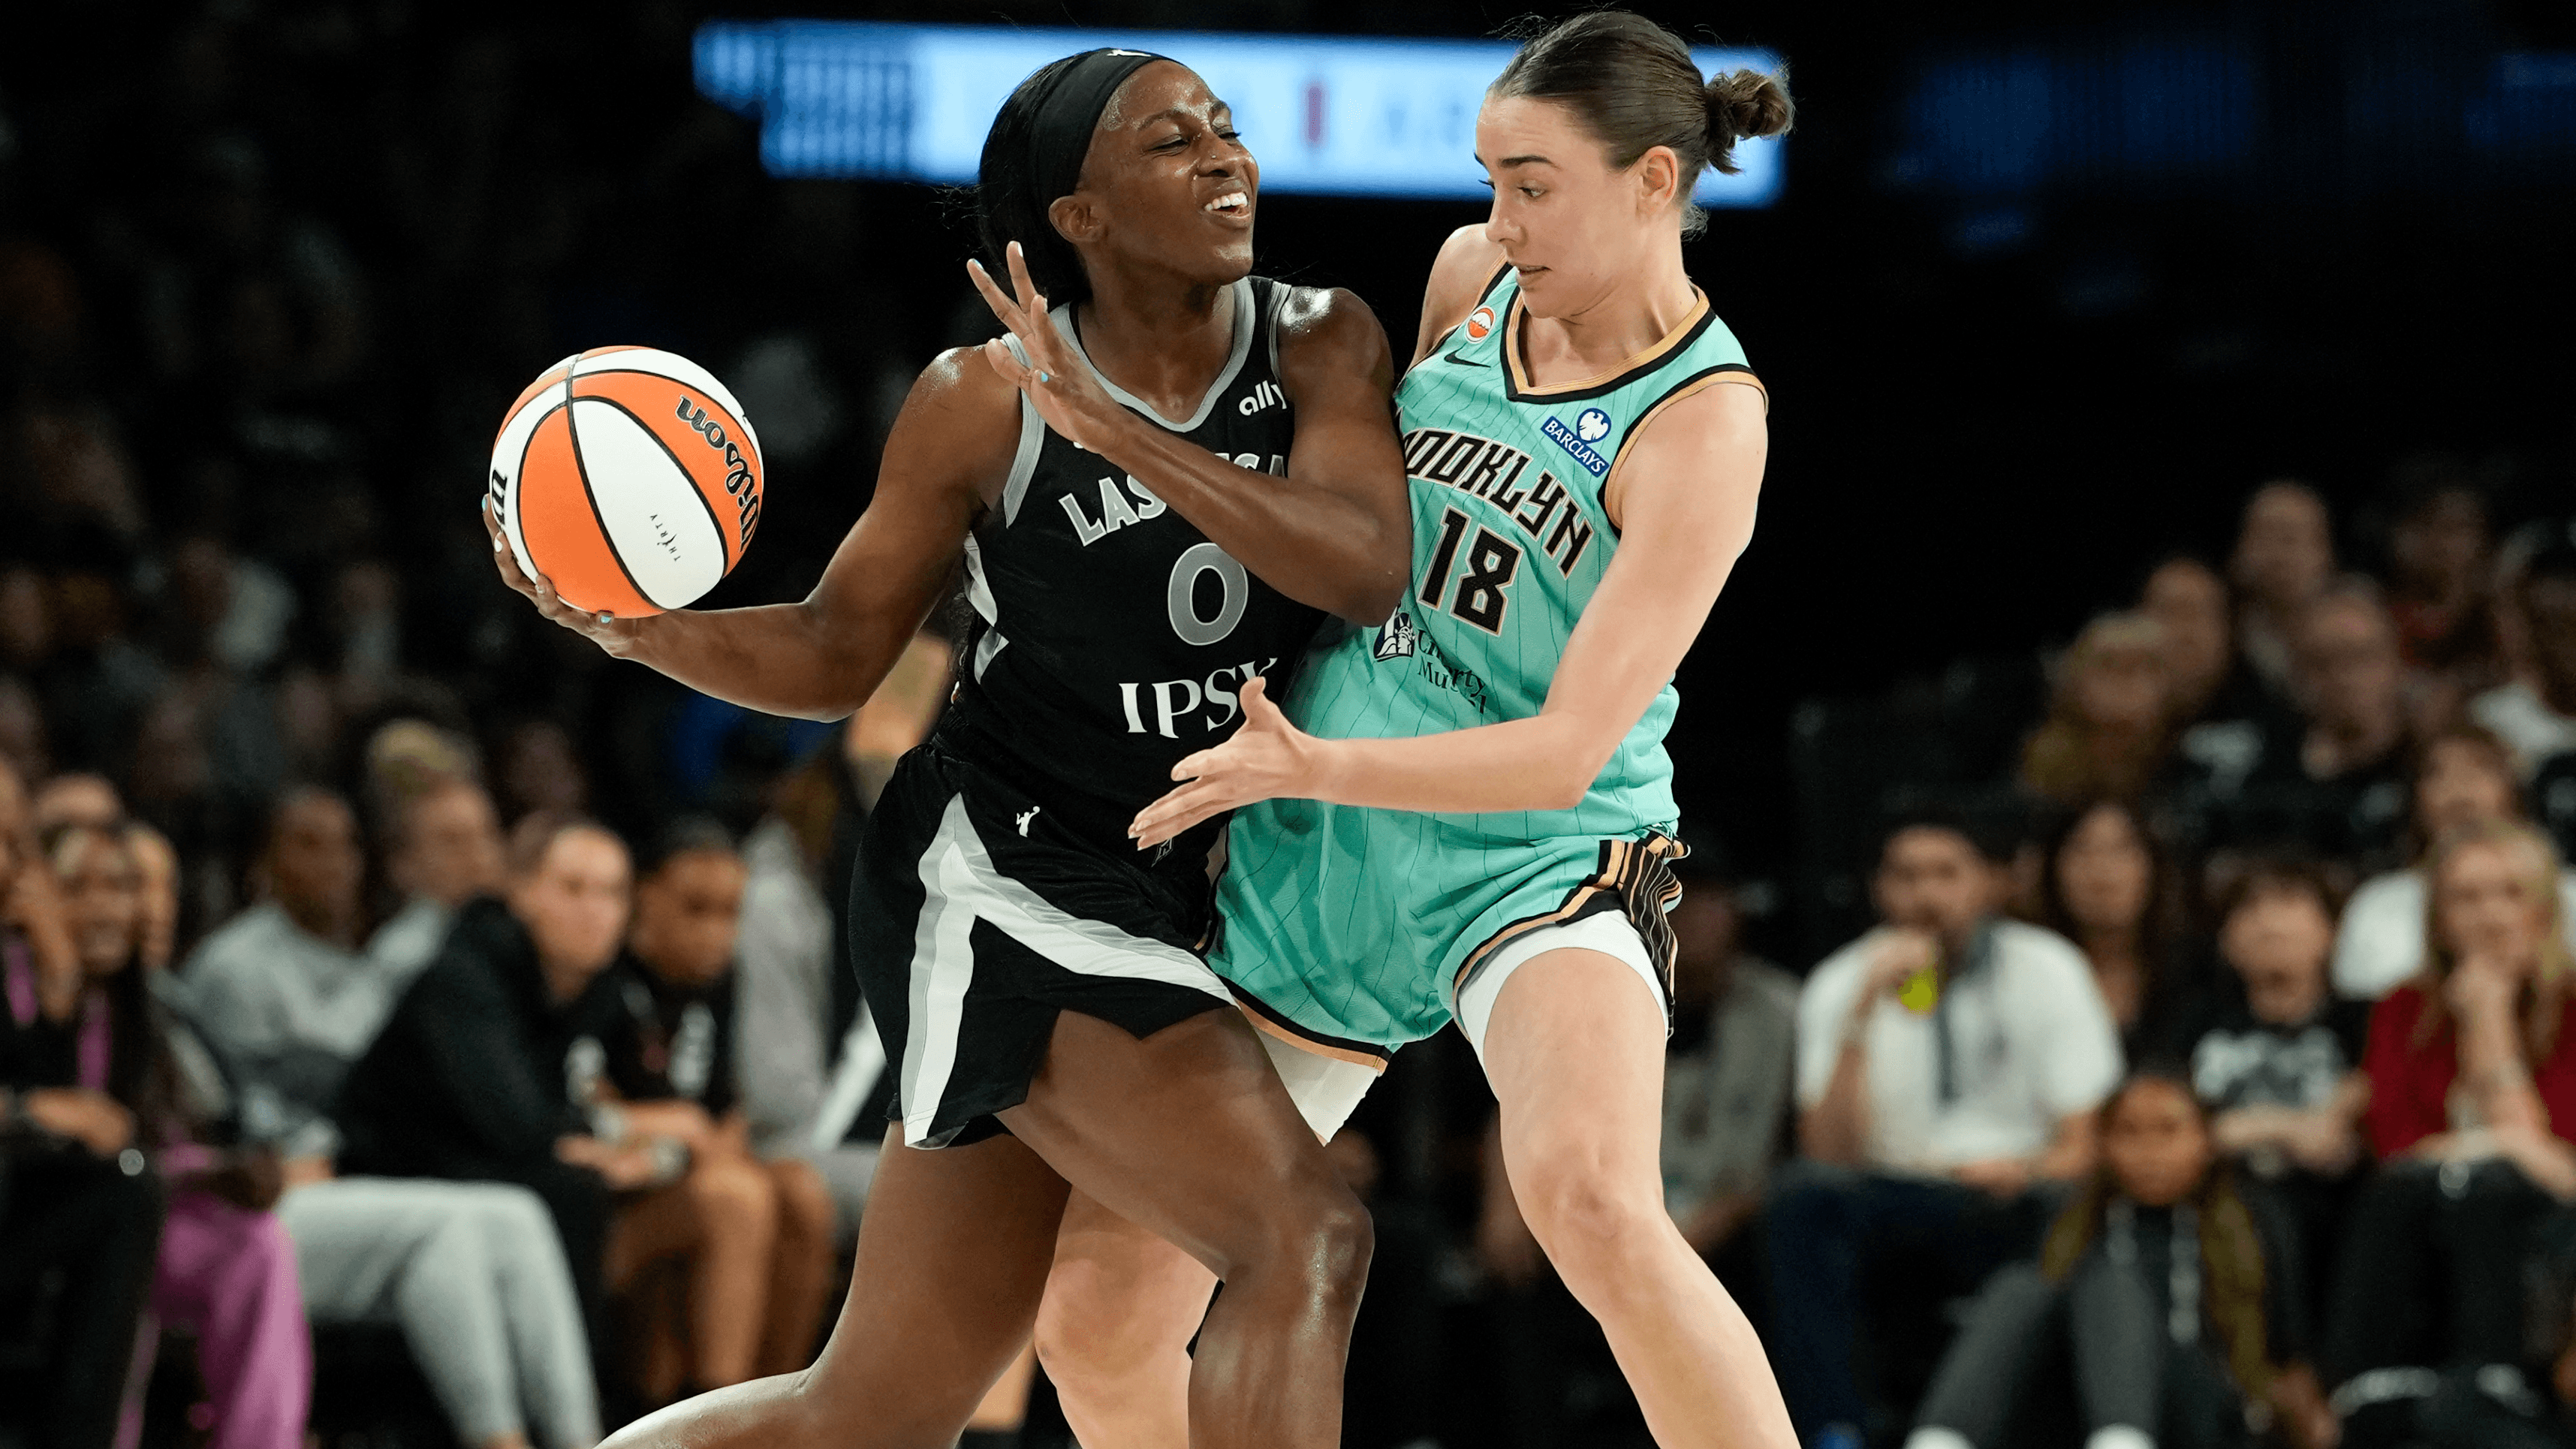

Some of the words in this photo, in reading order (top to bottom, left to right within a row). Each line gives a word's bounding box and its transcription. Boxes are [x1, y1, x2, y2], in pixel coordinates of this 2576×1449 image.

[675, 394, 759, 553] Wilson
[1544, 420, 1606, 473] BARCLAYS
[1058, 474, 1167, 547] LAS
[1402, 427, 1592, 580] OOKLYN
[1167, 542, 1249, 646] 0
[1416, 505, 1524, 637] 18
[1418, 628, 1486, 697] Lirty
